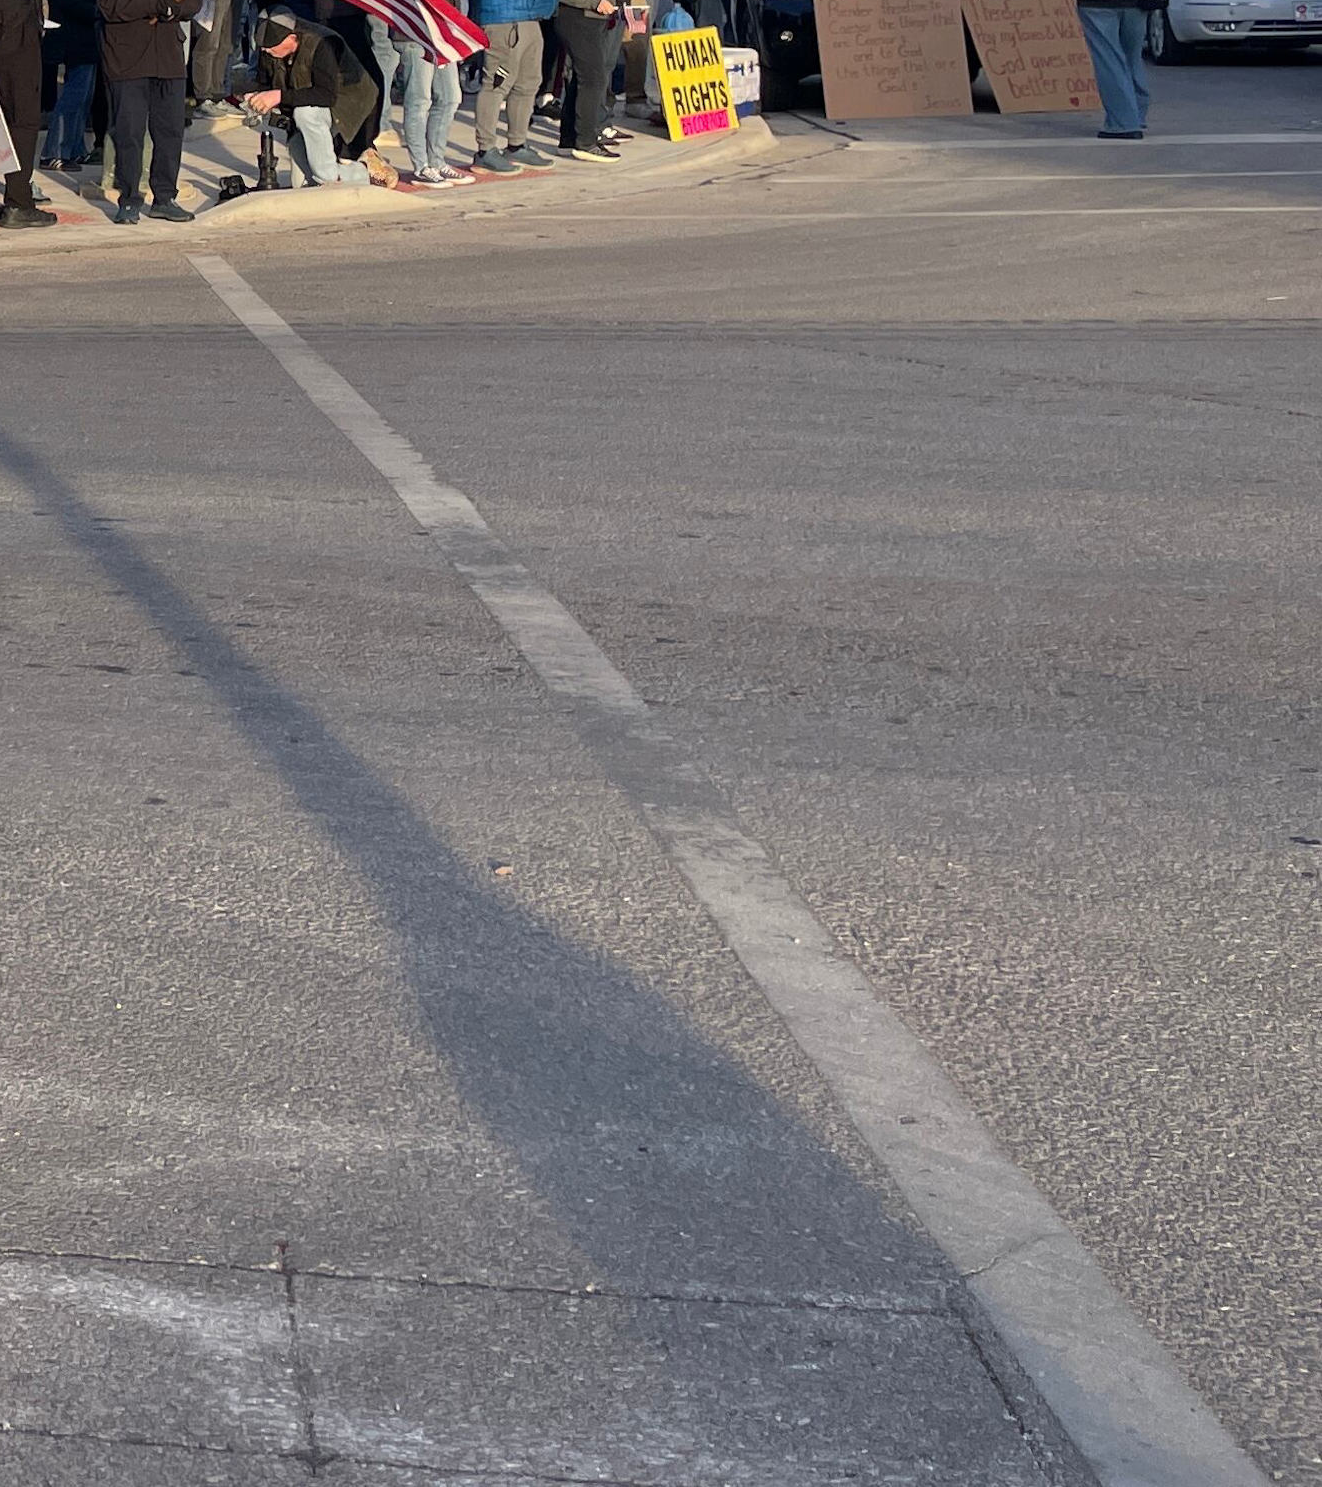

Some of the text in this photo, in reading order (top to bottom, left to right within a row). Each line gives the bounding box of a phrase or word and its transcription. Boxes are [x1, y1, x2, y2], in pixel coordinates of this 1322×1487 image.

[662, 36, 720, 72] HUMAN
[897, 45, 923, 58] God
[984, 48, 1026, 76] God
[671, 80, 729, 116] RIGHTS
